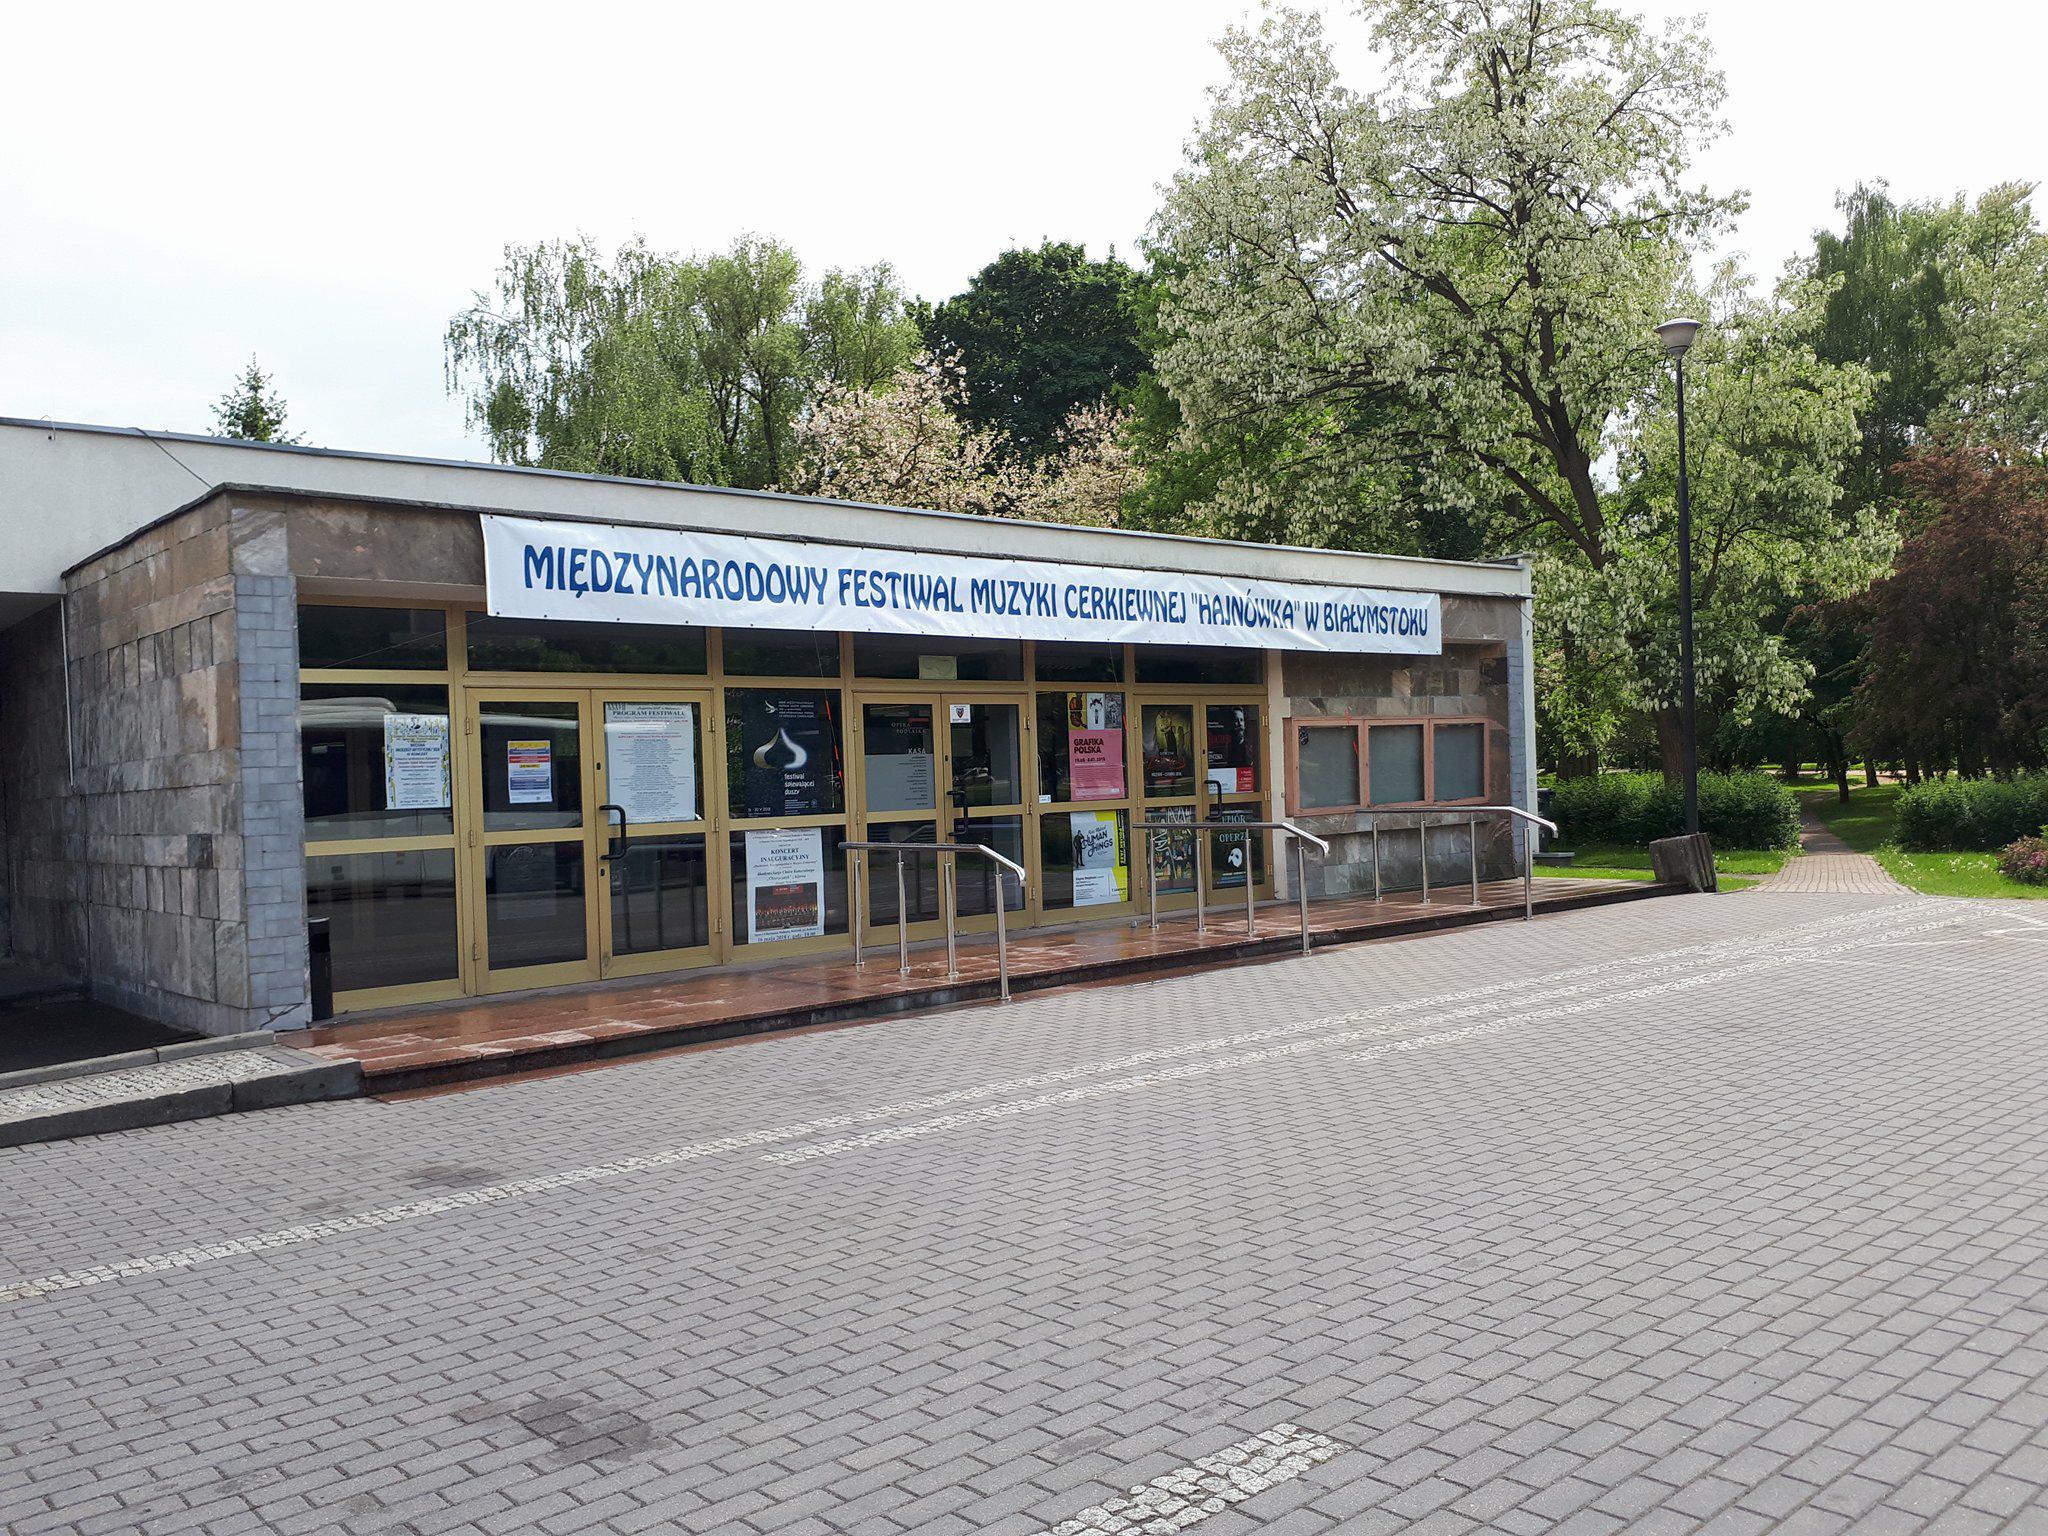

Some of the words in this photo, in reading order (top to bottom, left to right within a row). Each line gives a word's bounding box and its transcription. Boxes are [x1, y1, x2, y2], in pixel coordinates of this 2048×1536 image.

[524, 545, 827, 605] MIĘDZYNARODOWY
[838, 569, 963, 613] FESTIWAL
[971, 579, 1057, 617] MUZYKI
[1065, 585, 1187, 624] CERKIEWNEJ
[1190, 588, 1300, 629] "HAJNÓWKA"
[1304, 604, 1320, 632] W
[1324, 602, 1428, 636] BIAŁYMSTOKU
[1074, 738, 1104, 746] GRAFIKA
[1074, 746, 1101, 754] POLSKA
[770, 847, 799, 855] KONCERT
